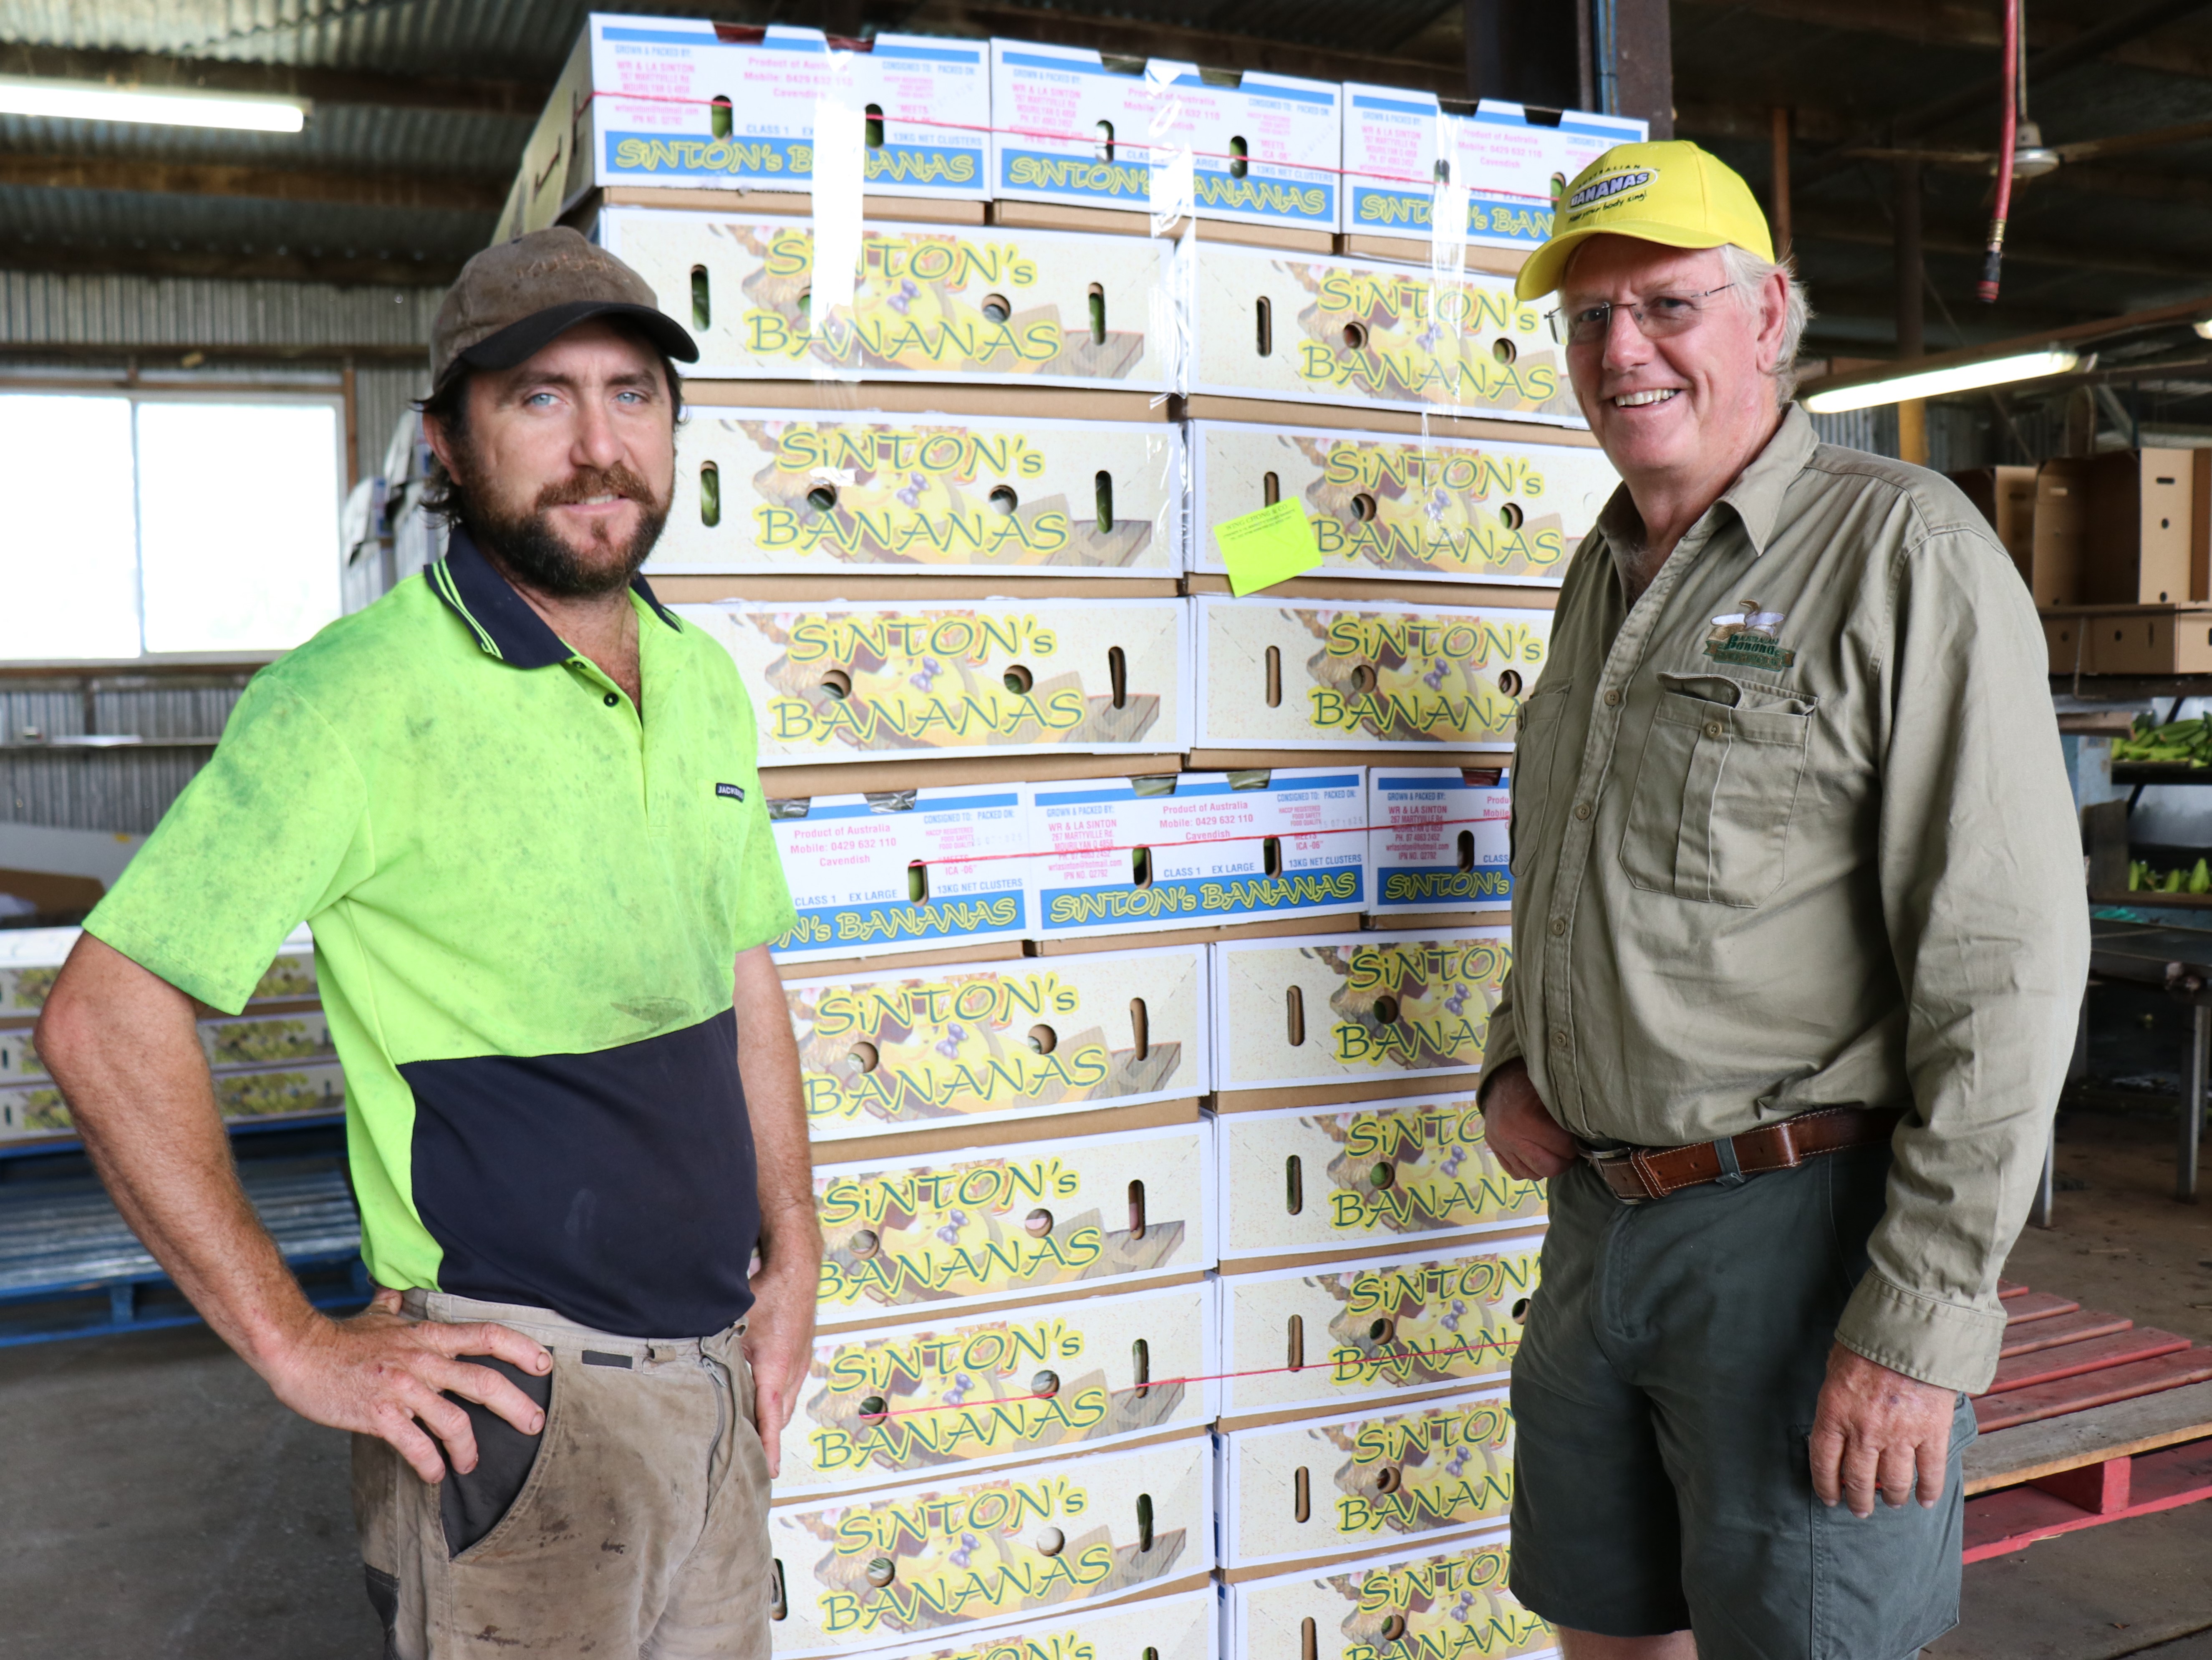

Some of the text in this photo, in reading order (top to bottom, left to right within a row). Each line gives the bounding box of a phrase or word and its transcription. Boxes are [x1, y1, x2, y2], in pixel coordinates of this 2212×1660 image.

[894, 133, 983, 146] 13KG NET CLUSTERS
[1504, 134, 1538, 144] Australia
[1491, 145, 1509, 154] 0429
[1511, 148, 1525, 156] 632
[1529, 149, 1542, 158] 110
[1481, 157, 1520, 168] Cavendish
[1257, 166, 1334, 183] 13KG NET CLUSTERS
[1571, 172, 1649, 207] BANANAS
[1302, 345, 1555, 401] BANANAS
[757, 508, 1069, 555] BANANAS
[1312, 519, 1562, 565] BANANAS
[772, 693, 1086, 744] BANANAS
[1277, 793, 1309, 802] CONSIGNED
[1324, 791, 1344, 799] PACKED
[1047, 805, 1115, 817] GROWN & PACKED BY:
[1163, 801, 1248, 814] Product of Australia
[924, 810, 1014, 824] CONSIGNED TO: PACKED ON:
[1160, 814, 1253, 829] Mobile: 0429 632 110
[795, 824, 890, 838] Product of Australia
[1049, 823, 1062, 831] WR
[1074, 821, 1084, 830] LA
[1087, 819, 1117, 829] SINTON
[1064, 830, 1102, 840] MARTYVILLE
[1186, 830, 1230, 840] Cavendish
[791, 838, 896, 854] Mobile: 0429 632 110
[1296, 842, 1307, 850] ICA
[820, 855, 870, 867] Cavendish
[1289, 859, 1307, 868] 13KG
[1325, 854, 1361, 865] CLUSTERS
[946, 866, 958, 875] ICA
[1164, 868, 1193, 878] CLASS
[1212, 865, 1224, 874] EX
[1226, 863, 1254, 872] LARGE
[937, 878, 1022, 894] 13KG NET CLUSTERS
[1199, 872, 1356, 911] BANANAS
[795, 889, 898, 907] CLASS 1 EX LARGE
[836, 897, 1017, 941] BANANAS
[802, 1048, 1108, 1117] BANANAS
[817, 1228, 1103, 1300] BANANAS
[812, 1390, 1107, 1471] BANANAS
[820, 1546, 1112, 1634] BANANAS
